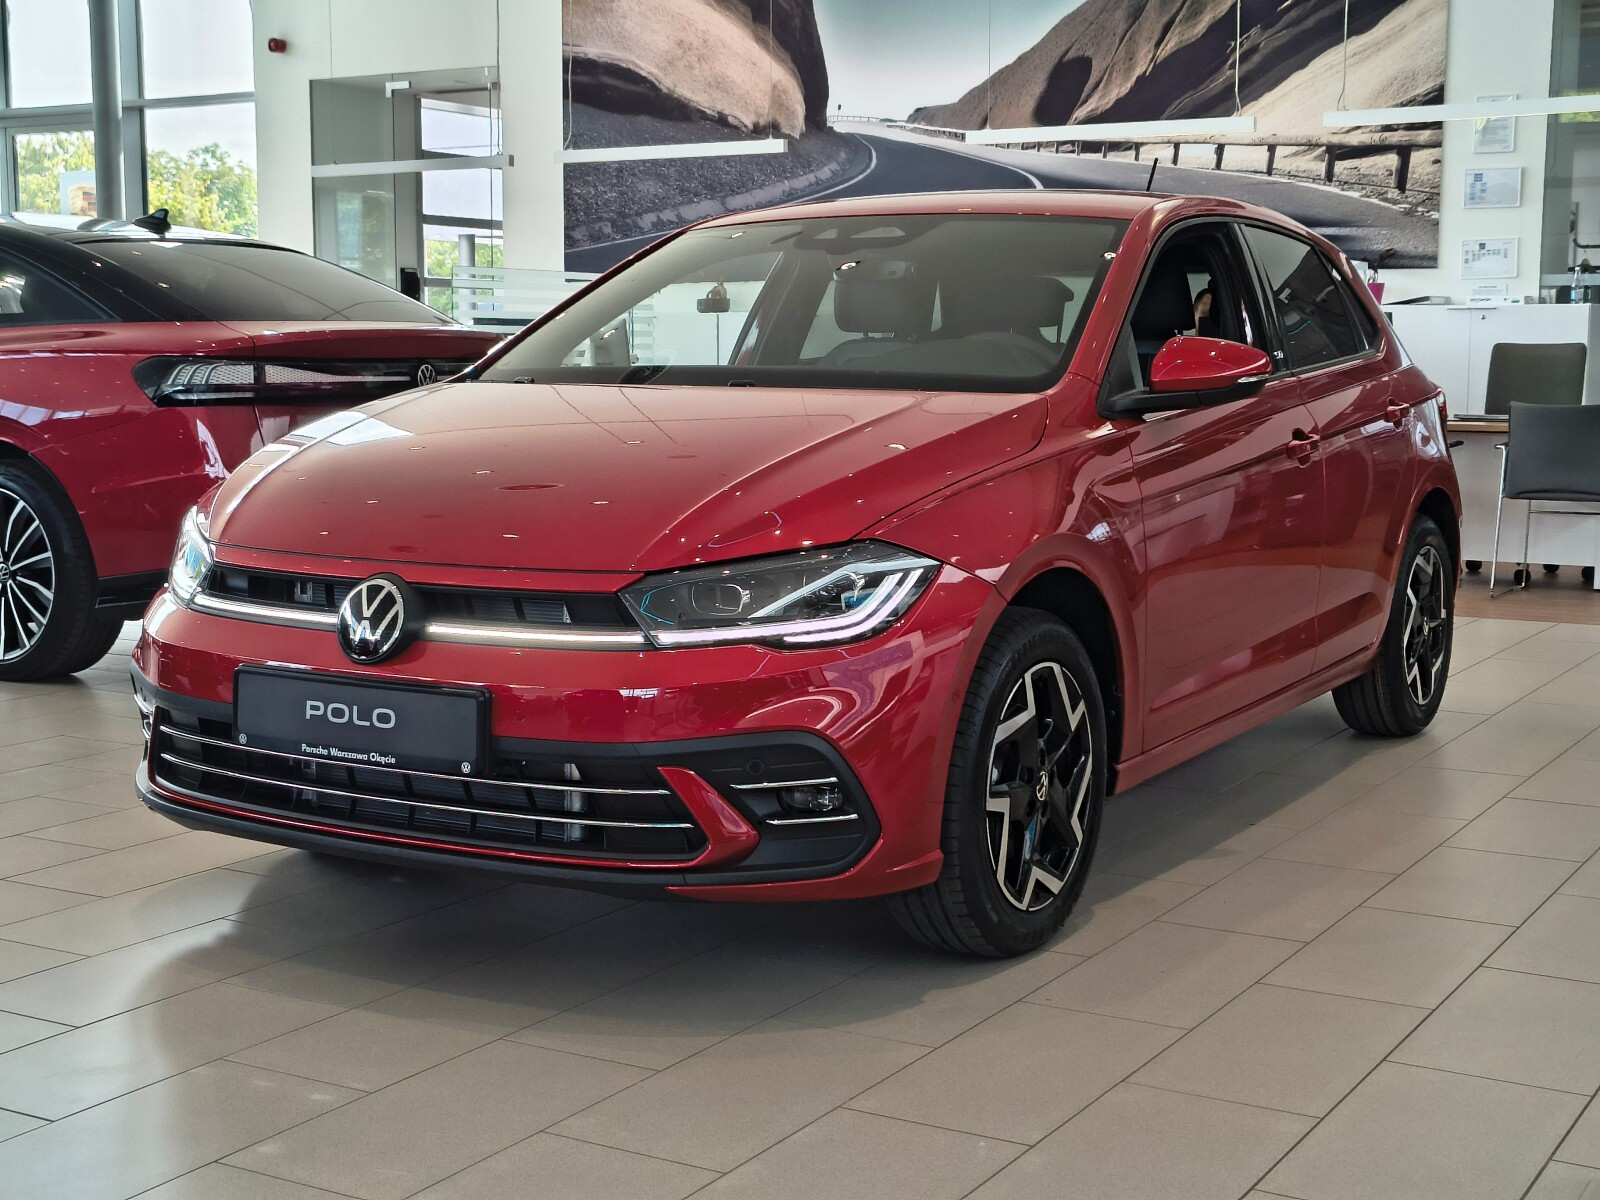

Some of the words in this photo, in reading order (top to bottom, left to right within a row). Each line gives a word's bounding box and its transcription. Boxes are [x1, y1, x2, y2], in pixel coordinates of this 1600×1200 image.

[337, 578, 404, 659] VW
[305, 699, 396, 729] POLO
[301, 743, 328, 756] Porsche
[329, 747, 368, 761] Warszawa
[369, 752, 396, 765] Okęcie
